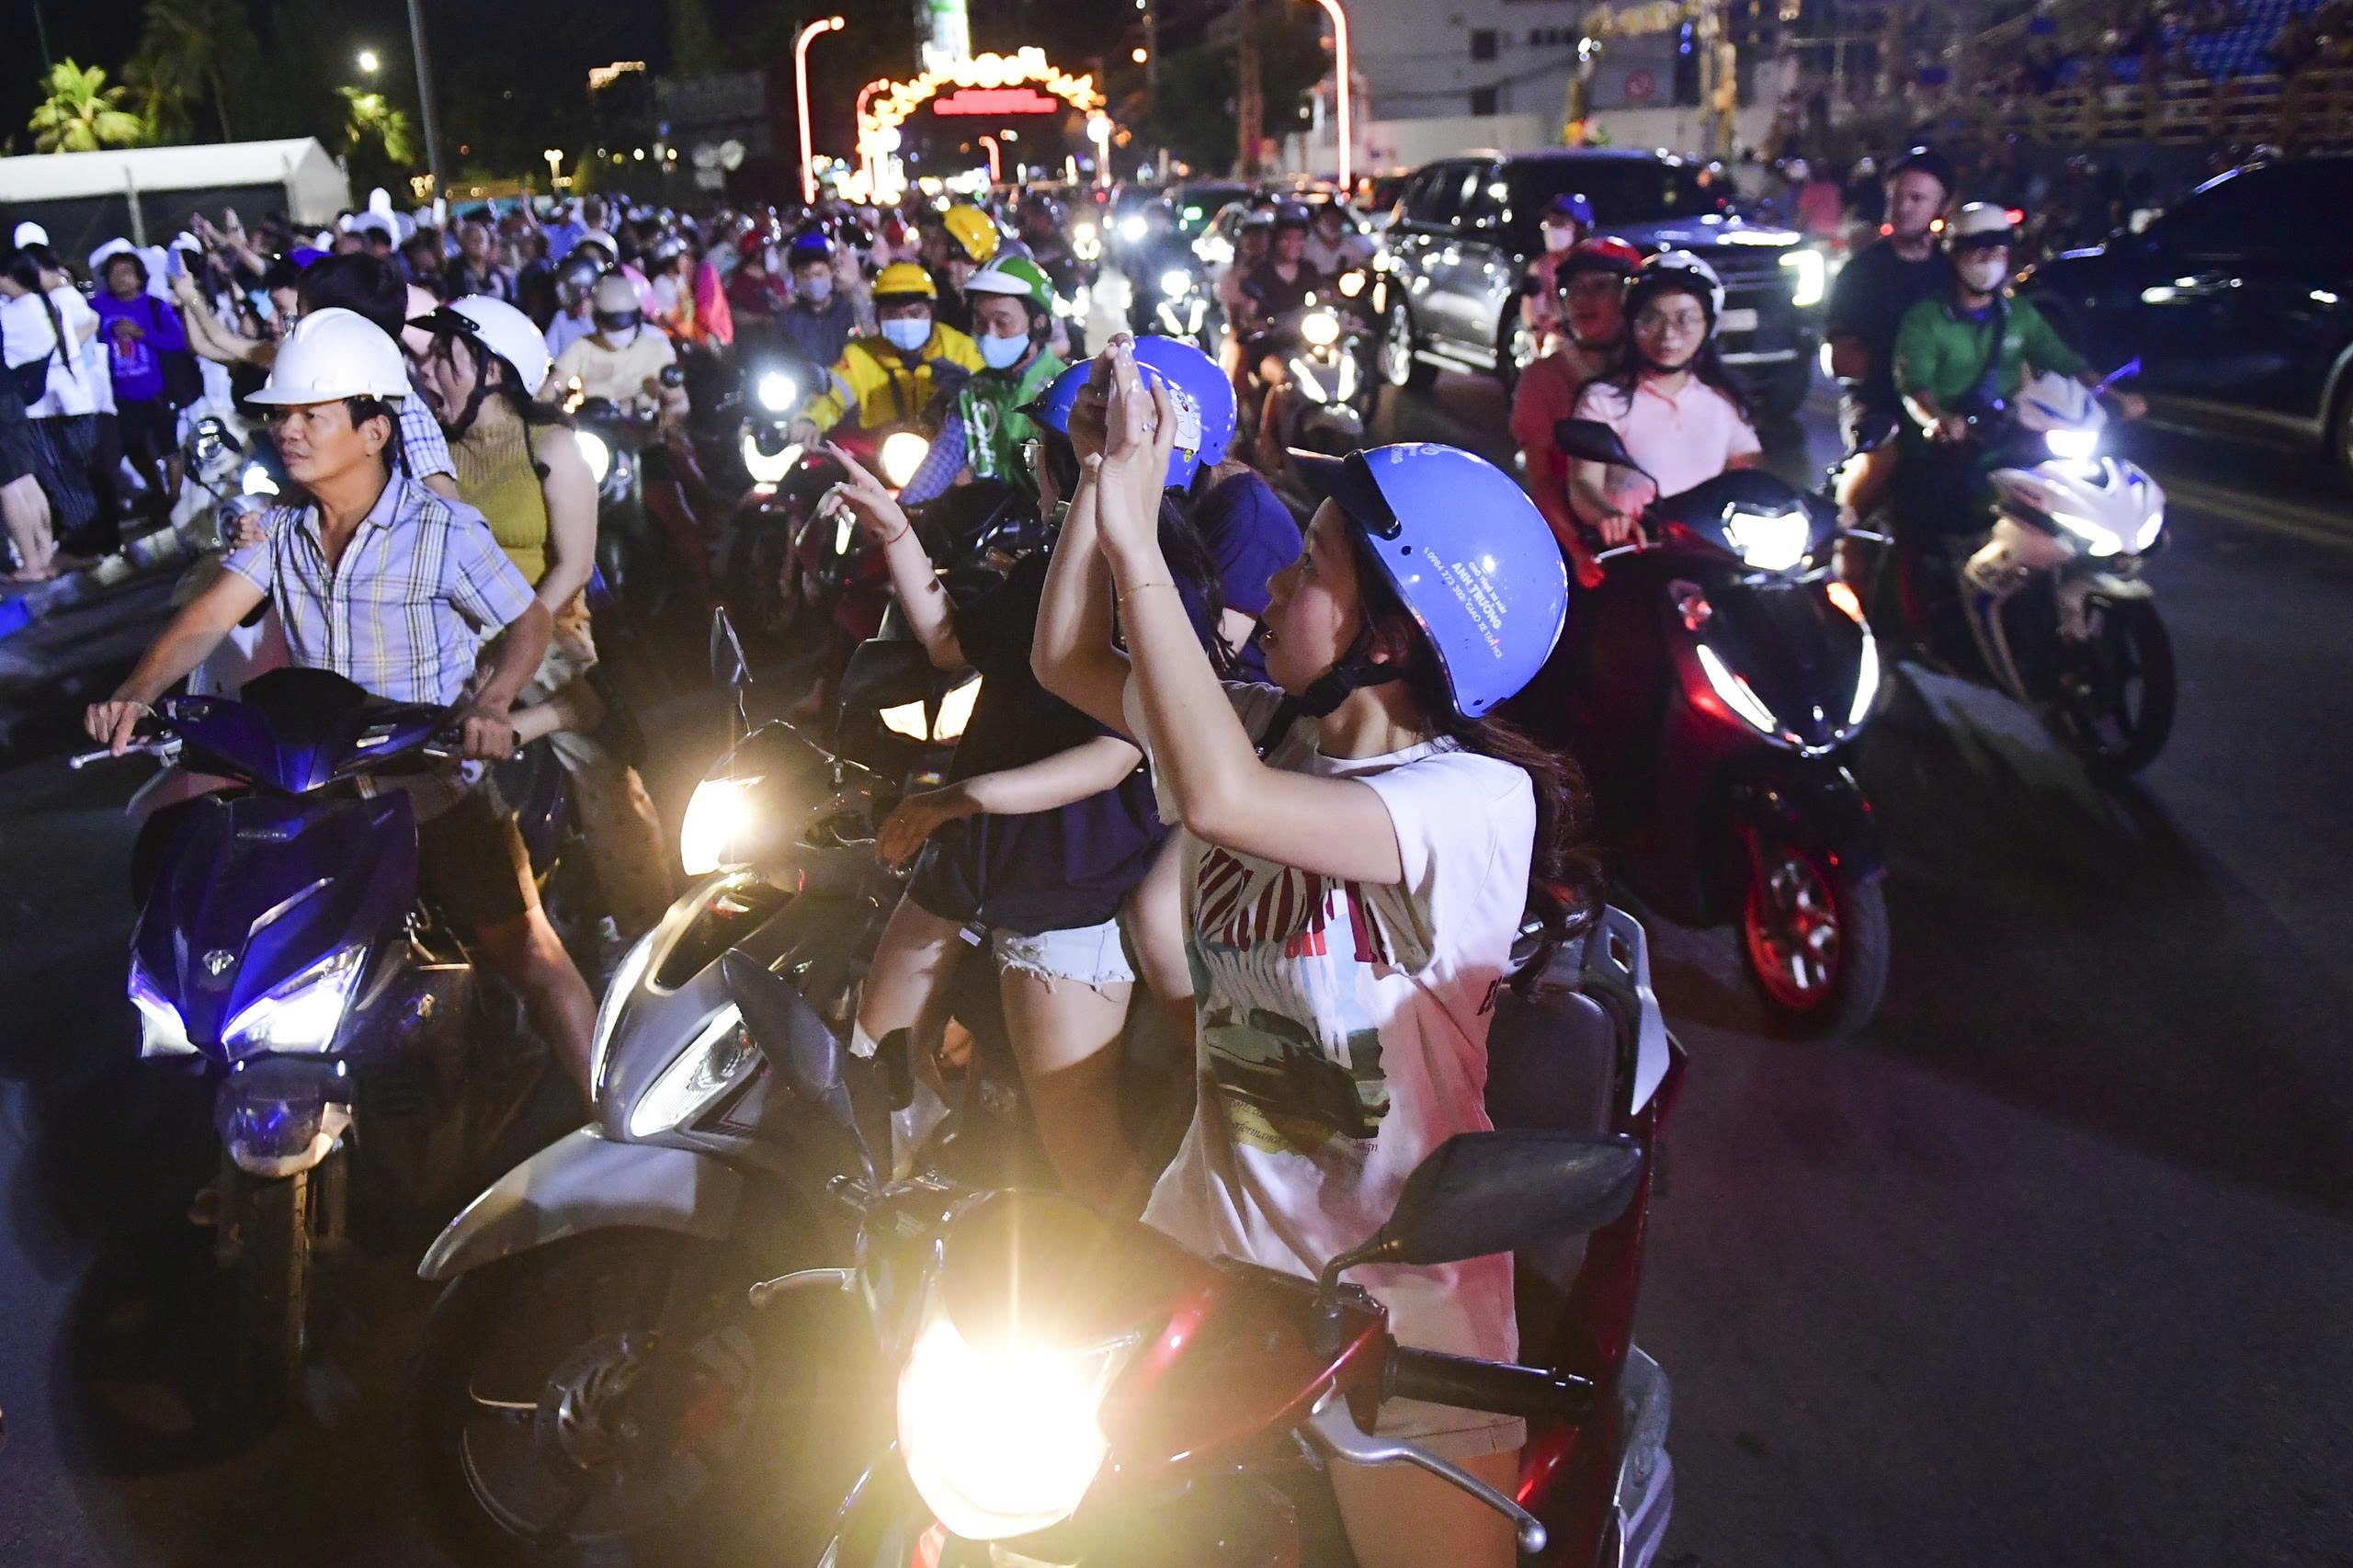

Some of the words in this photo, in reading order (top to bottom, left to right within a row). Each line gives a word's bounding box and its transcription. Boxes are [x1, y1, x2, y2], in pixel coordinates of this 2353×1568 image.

[1427, 551, 1444, 571] 0984
[1441, 570, 1455, 585] 273
[1452, 562, 1473, 586] ANH
[1478, 621, 1488, 633] XE
